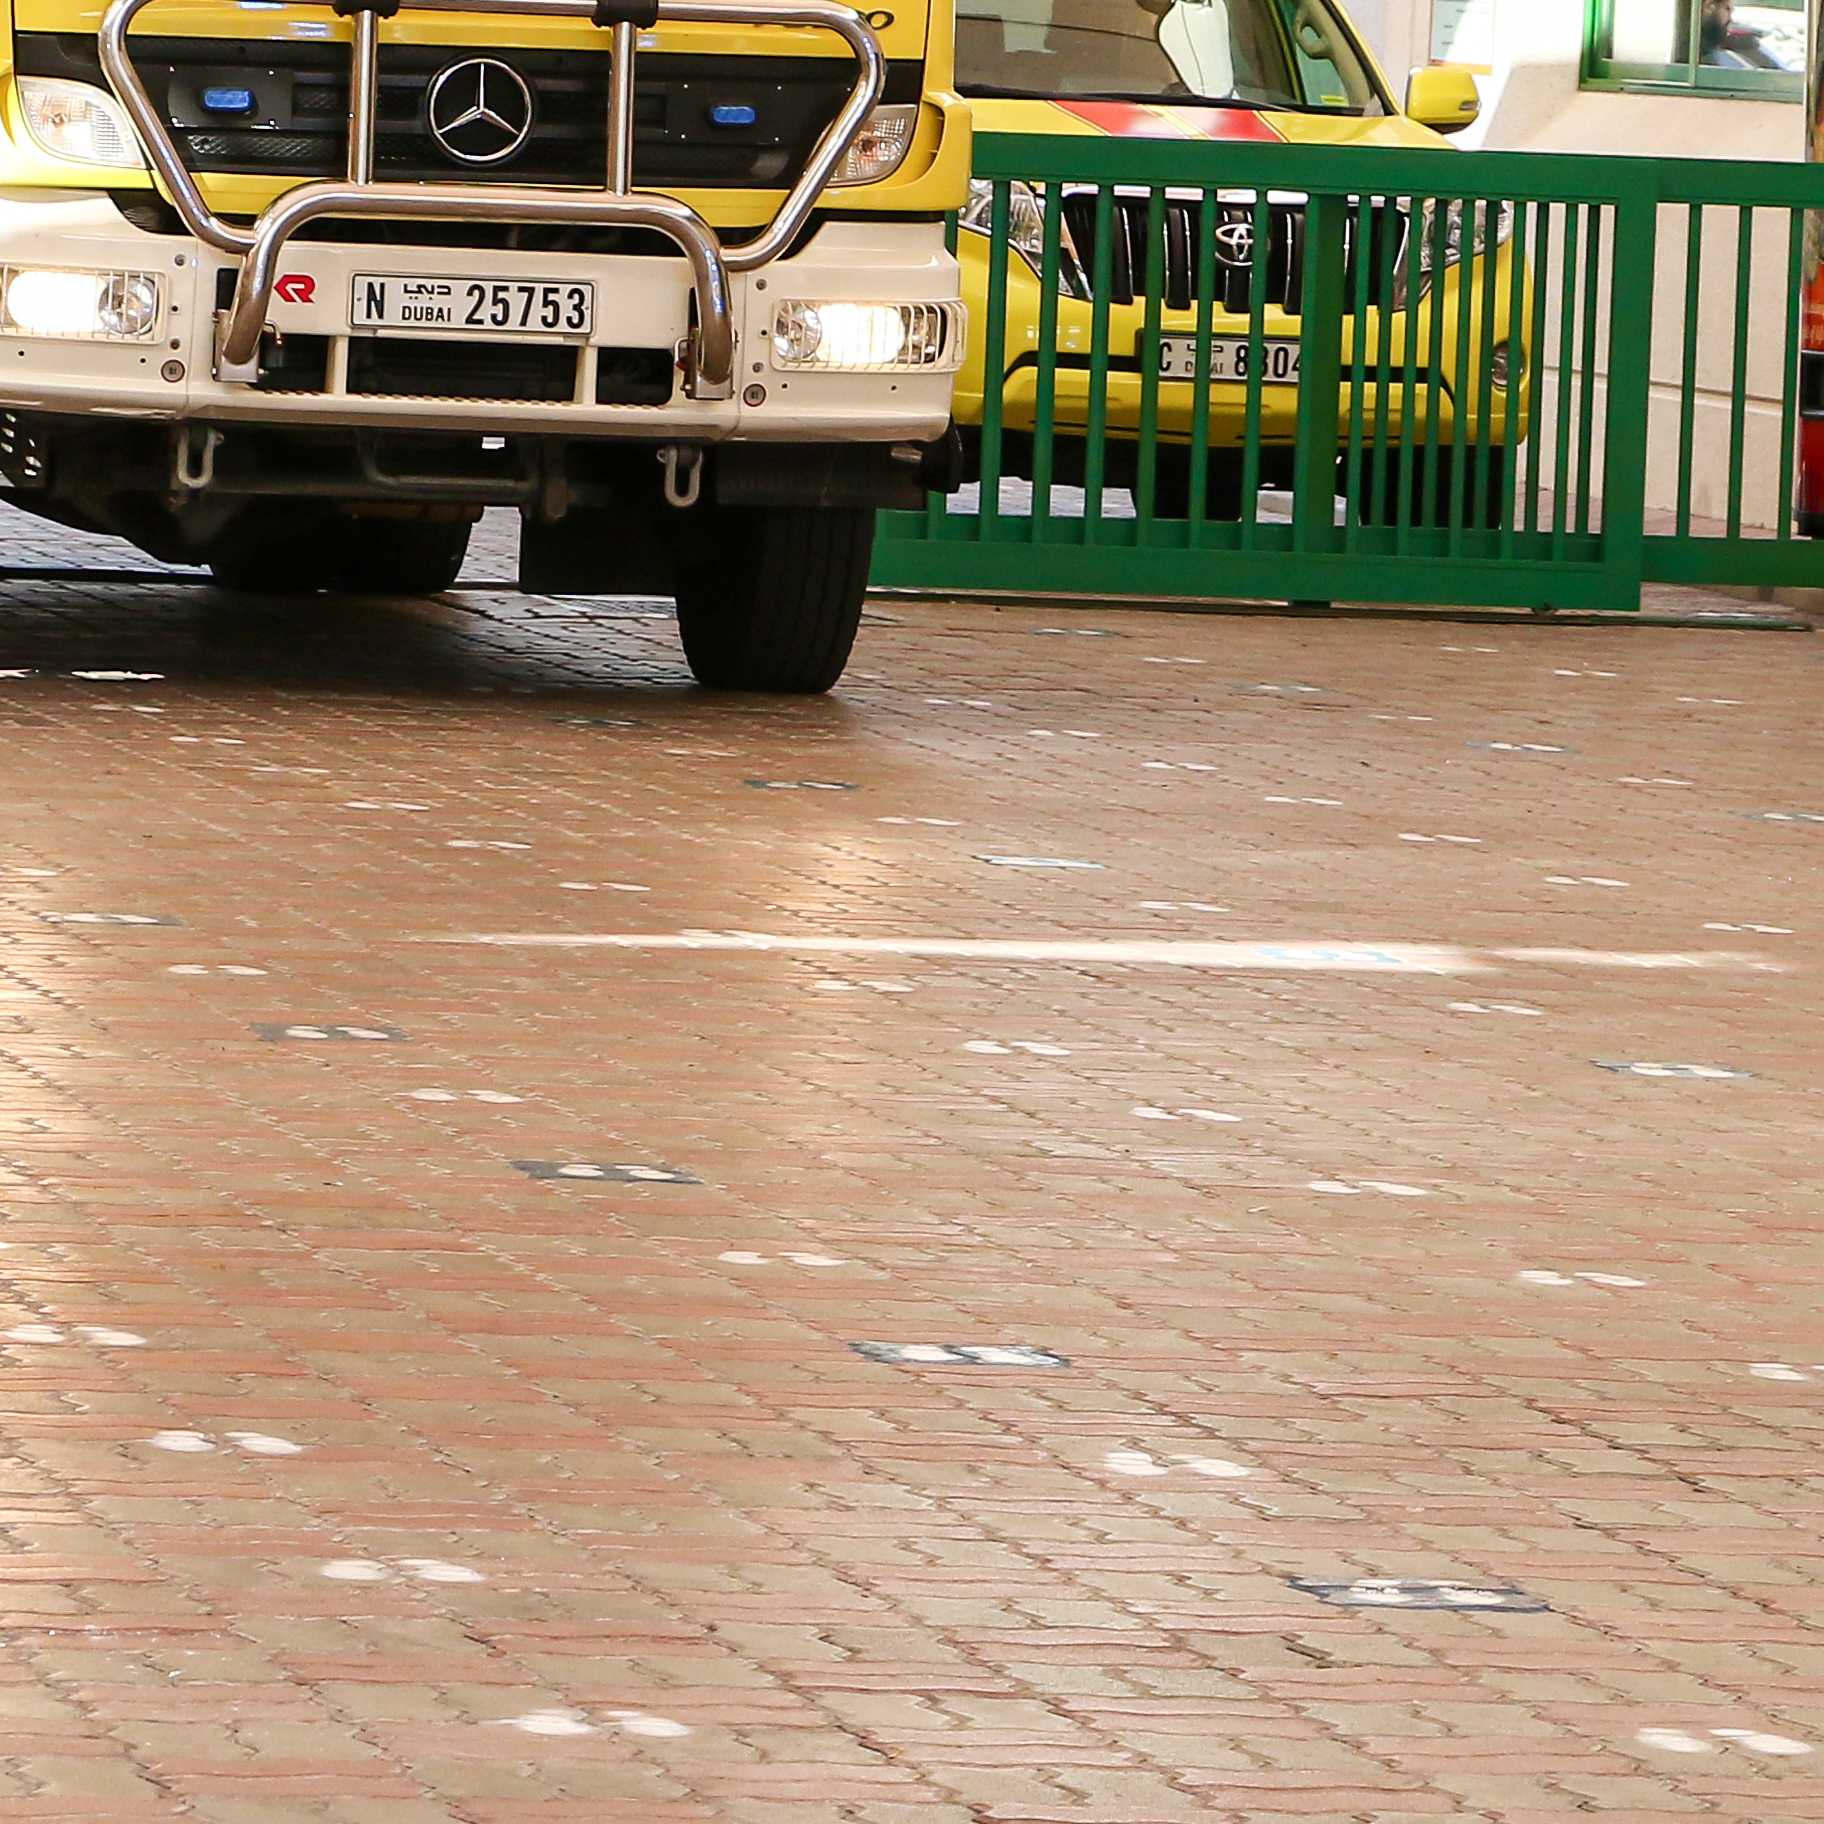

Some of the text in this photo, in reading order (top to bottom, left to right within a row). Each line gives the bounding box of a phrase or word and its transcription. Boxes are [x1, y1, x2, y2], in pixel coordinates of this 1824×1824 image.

[365, 281, 586, 329] N DUBAI 25753
[402, 283, 452, 300] دبي
